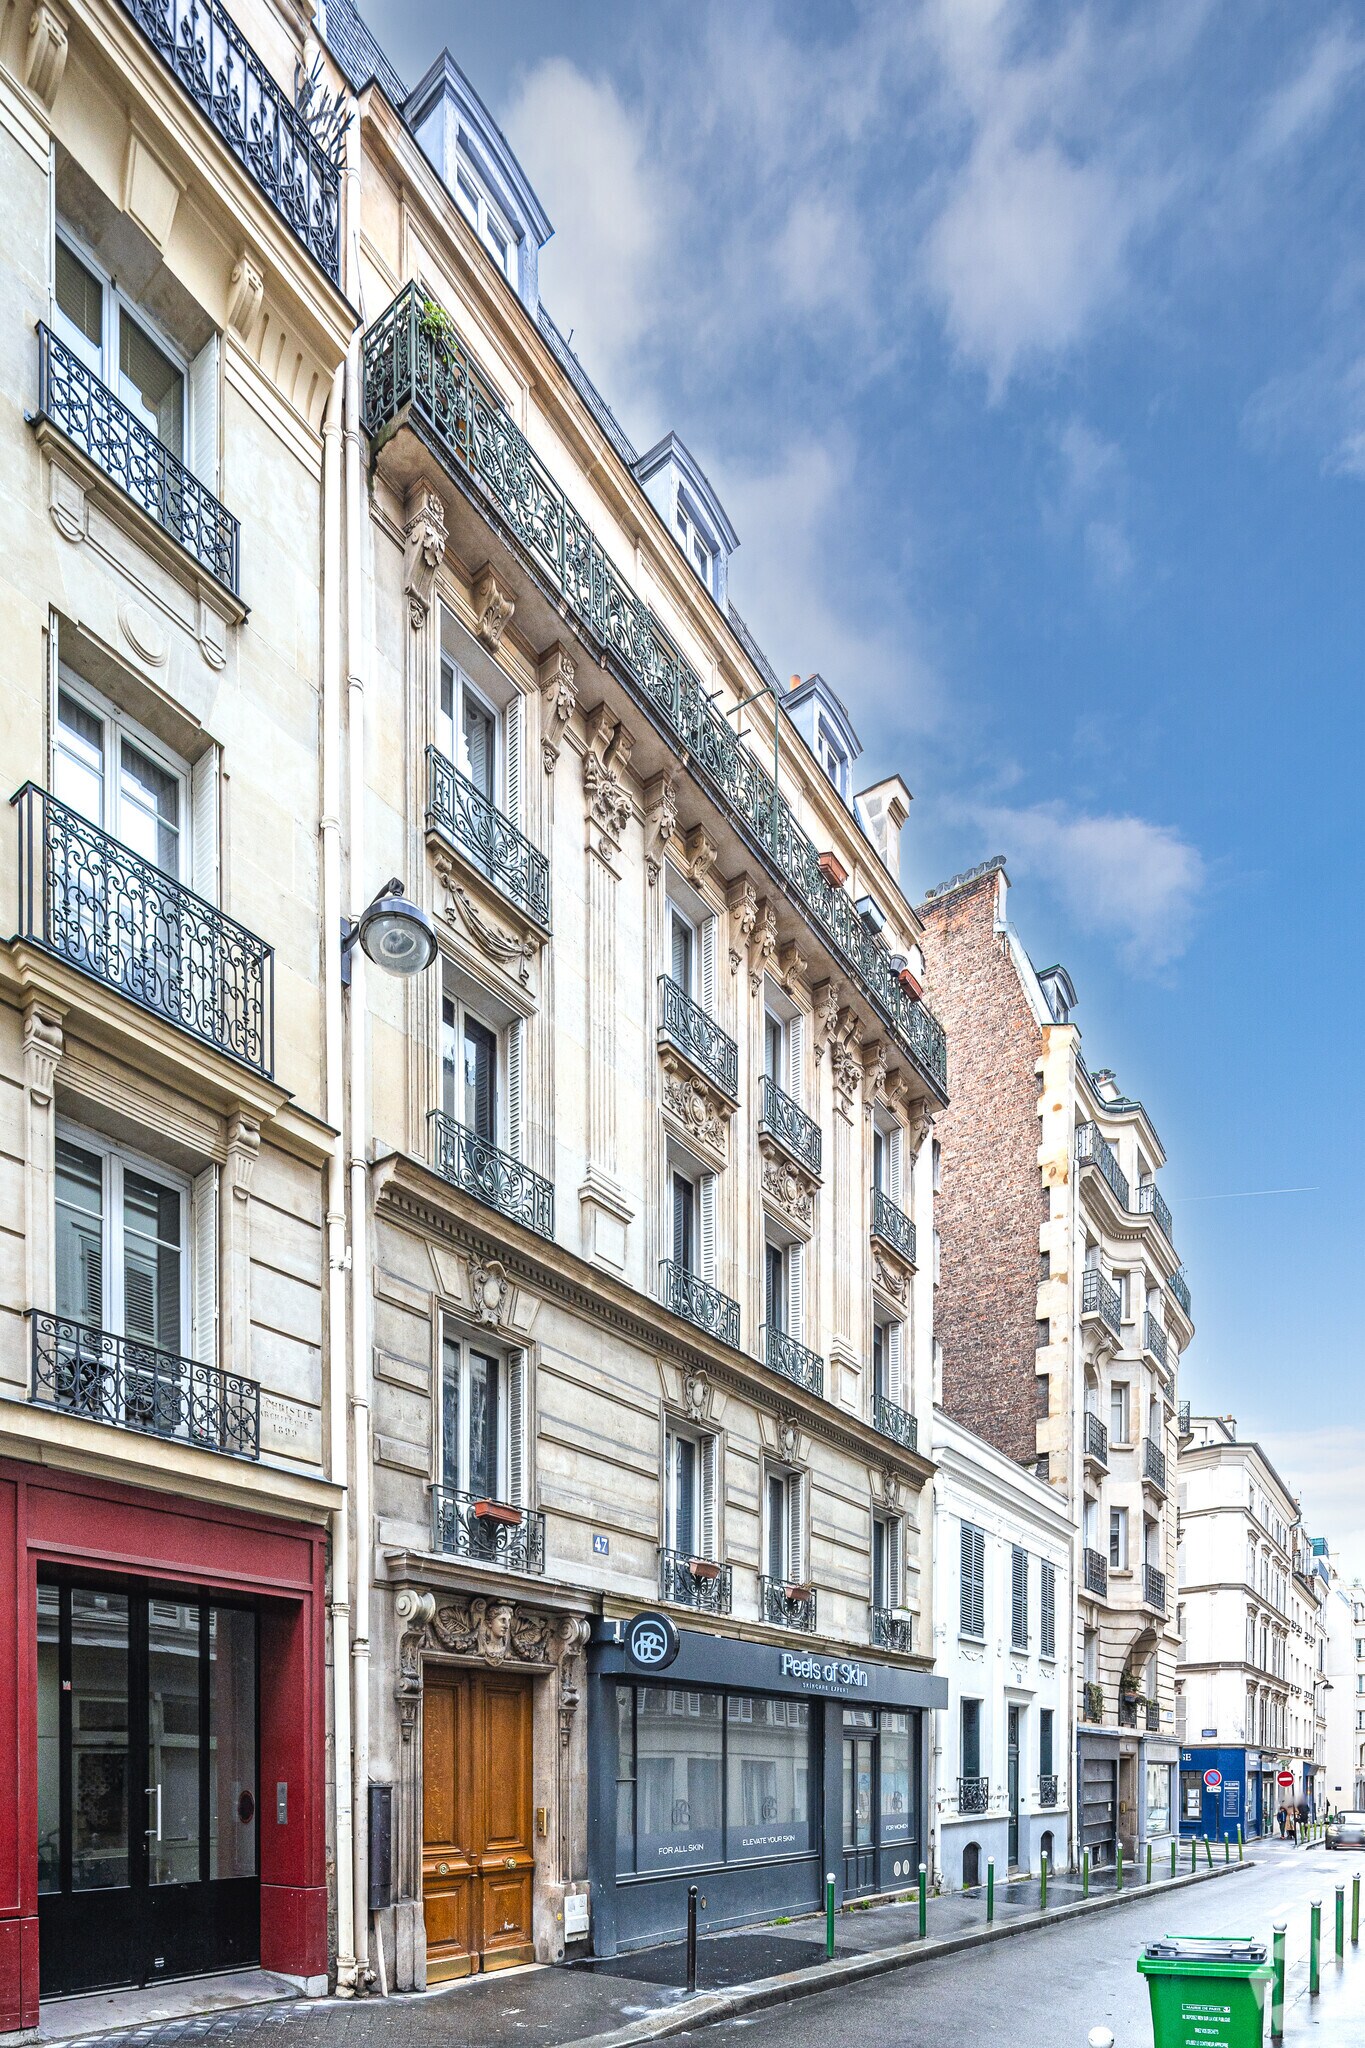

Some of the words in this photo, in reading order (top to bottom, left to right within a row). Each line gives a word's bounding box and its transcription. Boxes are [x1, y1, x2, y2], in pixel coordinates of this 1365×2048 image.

[594, 1536, 608, 1553] 47
[781, 1653, 821, 1680] Peels
[823, 1662, 838, 1682] of
[840, 1663, 868, 1687] Skin
[742, 1837, 767, 1846] ELEVATE
[767, 1836, 782, 1844] YOUR
[783, 1834, 796, 1842] SKIN
[658, 1845, 673, 1855] FOR
[674, 1845, 688, 1853] ALL
[688, 1843, 704, 1852] SKIN
